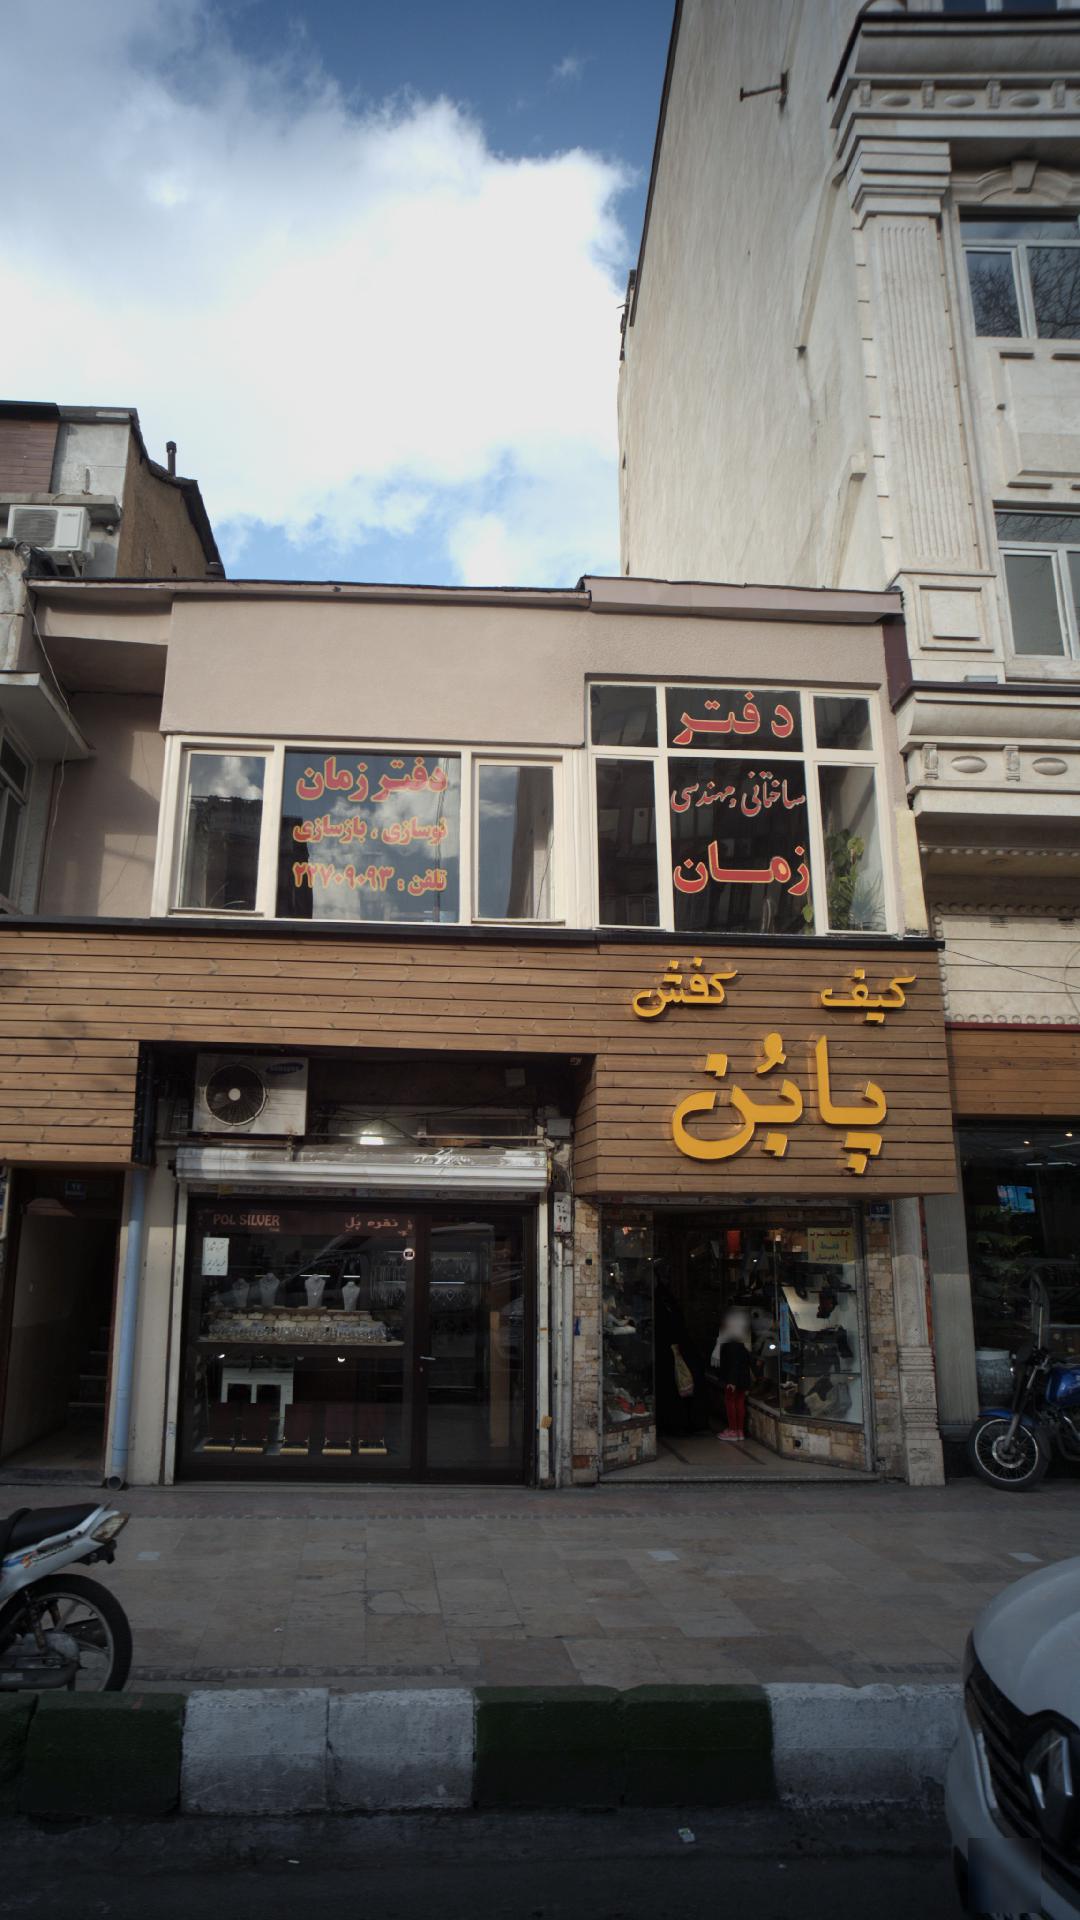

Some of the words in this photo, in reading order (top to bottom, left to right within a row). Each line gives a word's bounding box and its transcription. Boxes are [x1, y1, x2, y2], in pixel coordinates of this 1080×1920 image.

[672, 691, 794, 745] دفتر
[296, 756, 369, 802] زمان
[371, 757, 448, 802] دفتر
[670, 781, 735, 813] مهندسی
[741, 770, 806, 817] ساختمانی
[293, 815, 367, 844] بازسازی
[673, 840, 810, 896] زمان
[631, 957, 737, 1018] کفش
[819, 968, 915, 1021] کیف
[212, 1213, 236, 1225] POL
[239, 1214, 280, 1227] SILVER
[367, 1218, 399, 1229] نقره
